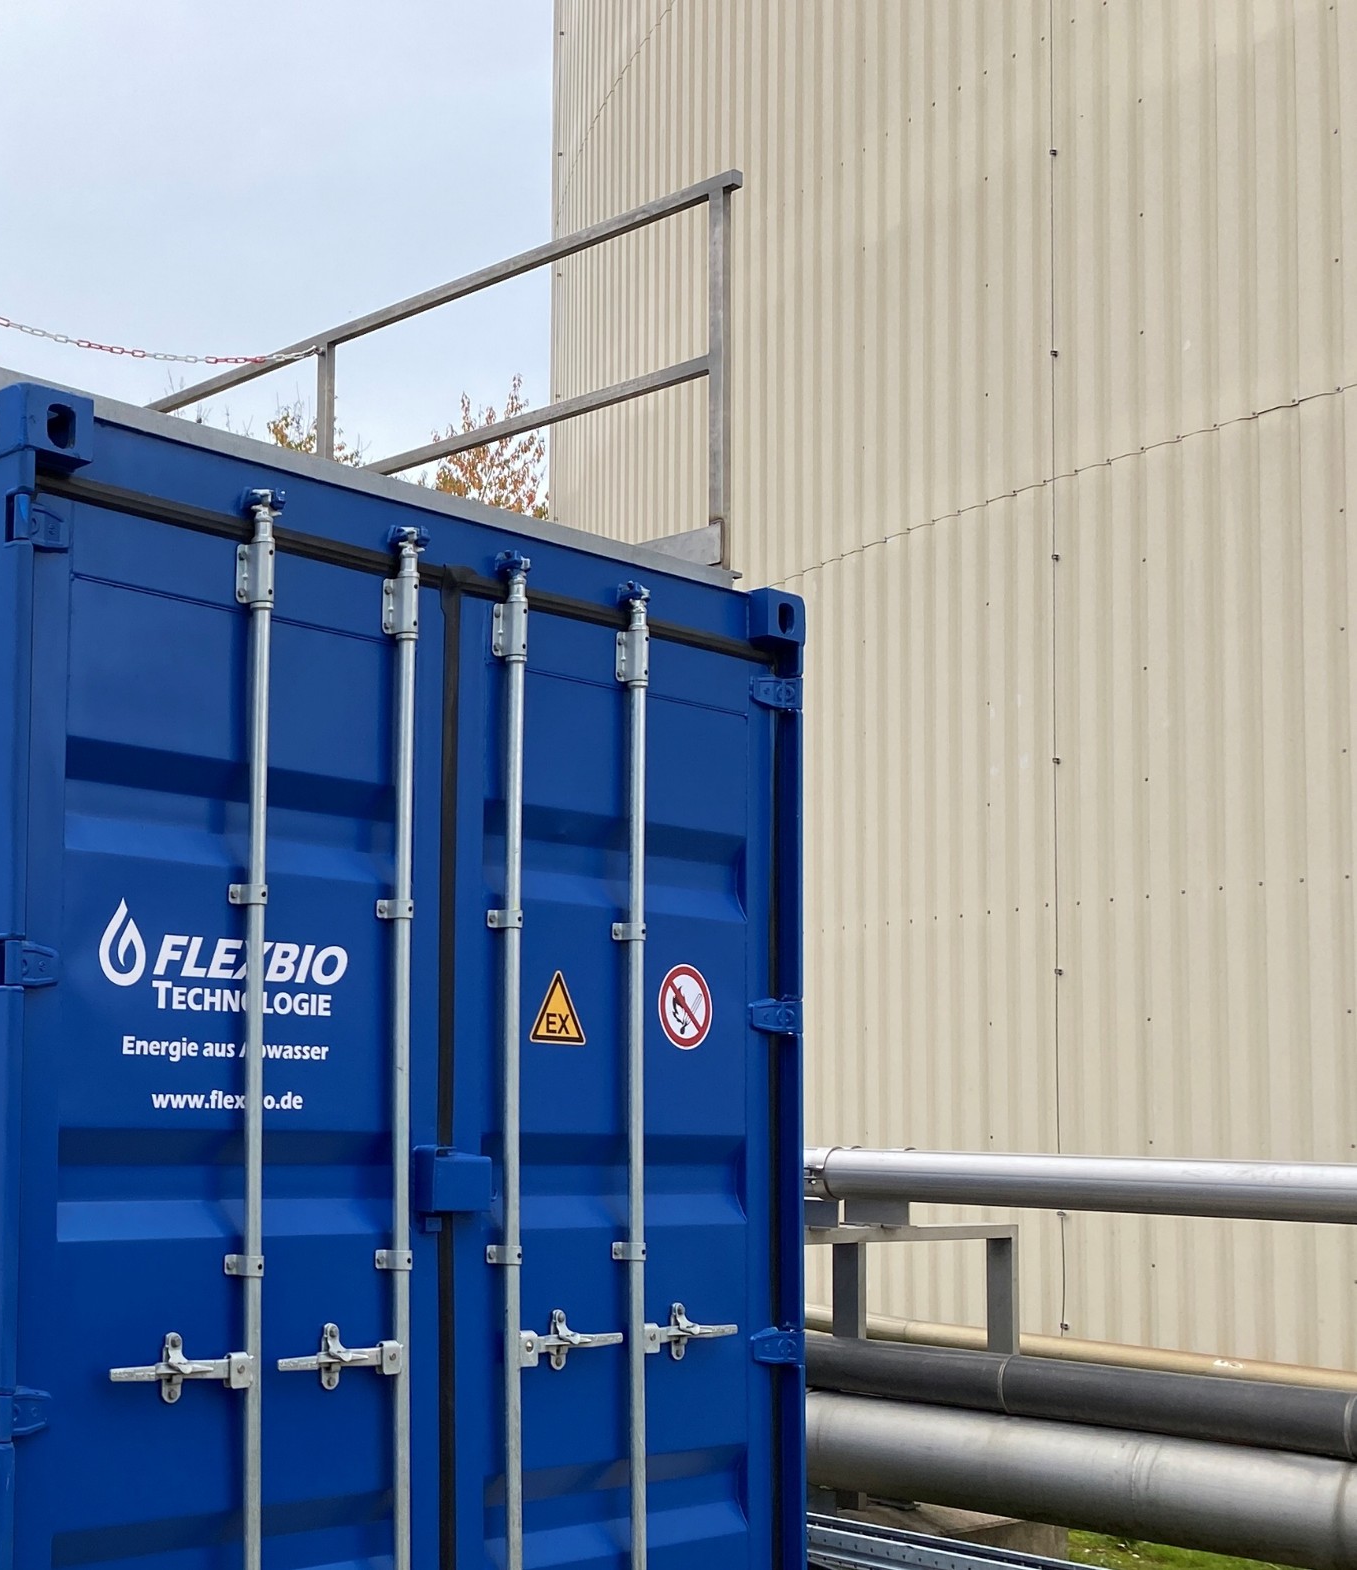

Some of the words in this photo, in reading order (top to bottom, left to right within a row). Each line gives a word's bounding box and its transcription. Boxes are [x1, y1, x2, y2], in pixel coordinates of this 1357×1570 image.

[546, 1012, 570, 1035] EX
[122, 1035, 198, 1062] Energie
[202, 1043, 236, 1058] aus
[151, 1089, 303, 1110] www.flexo.de
